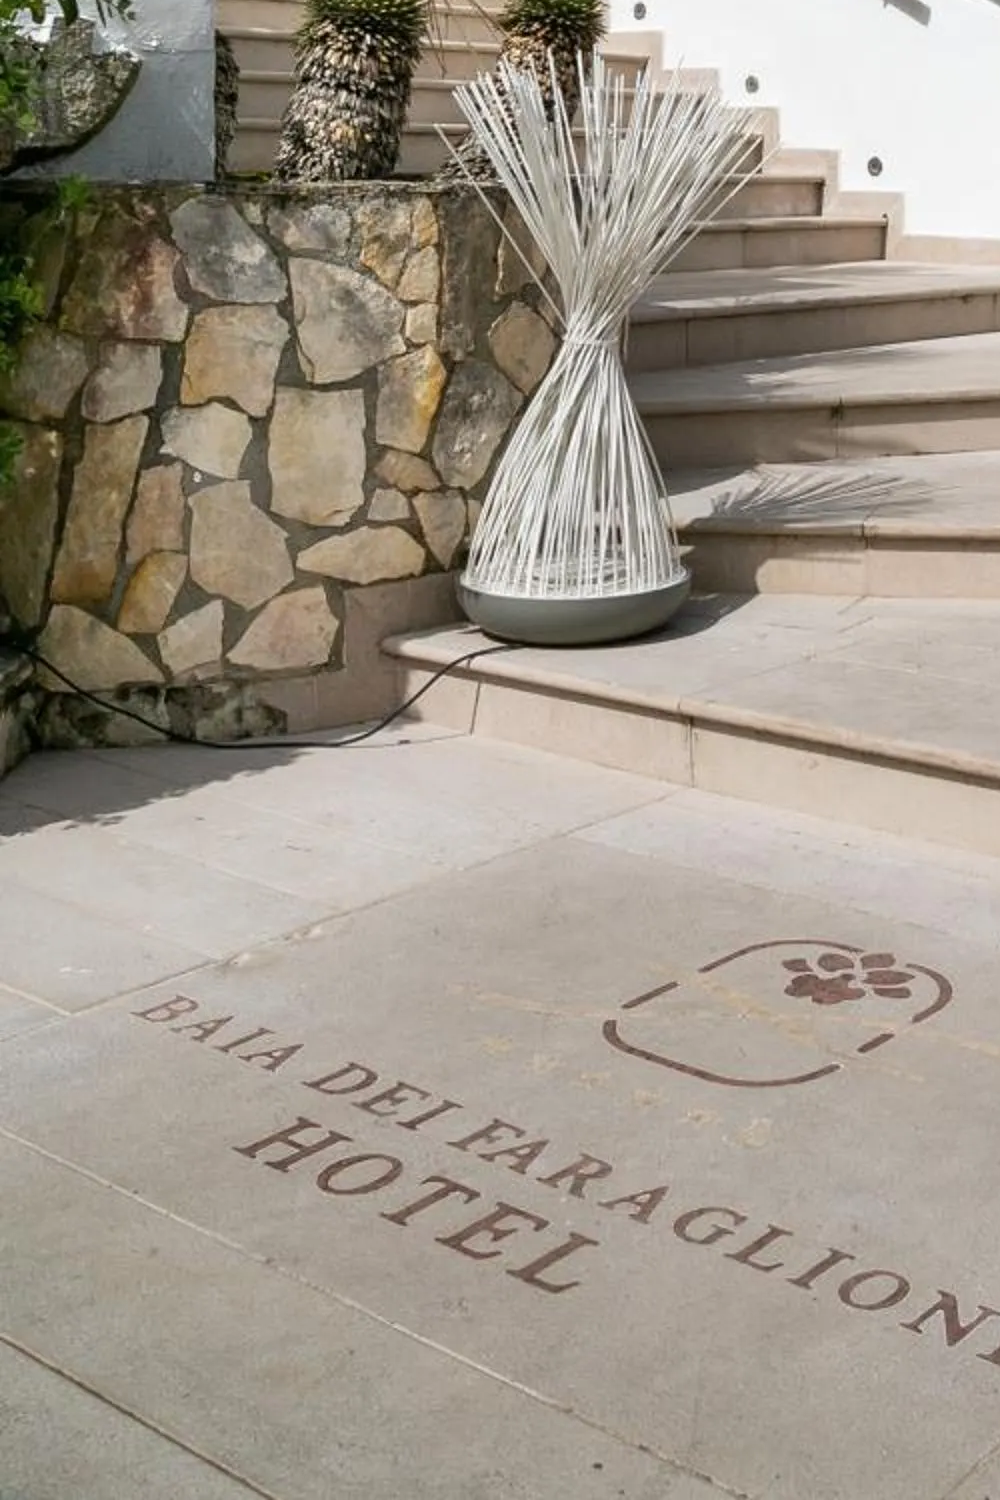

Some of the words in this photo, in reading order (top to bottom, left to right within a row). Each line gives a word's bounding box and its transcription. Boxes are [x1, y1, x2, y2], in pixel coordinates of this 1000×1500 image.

[130, 994, 305, 1072] BAIA
[302, 1061, 465, 1132] DEI
[233, 1116, 599, 1294] HOTEL
